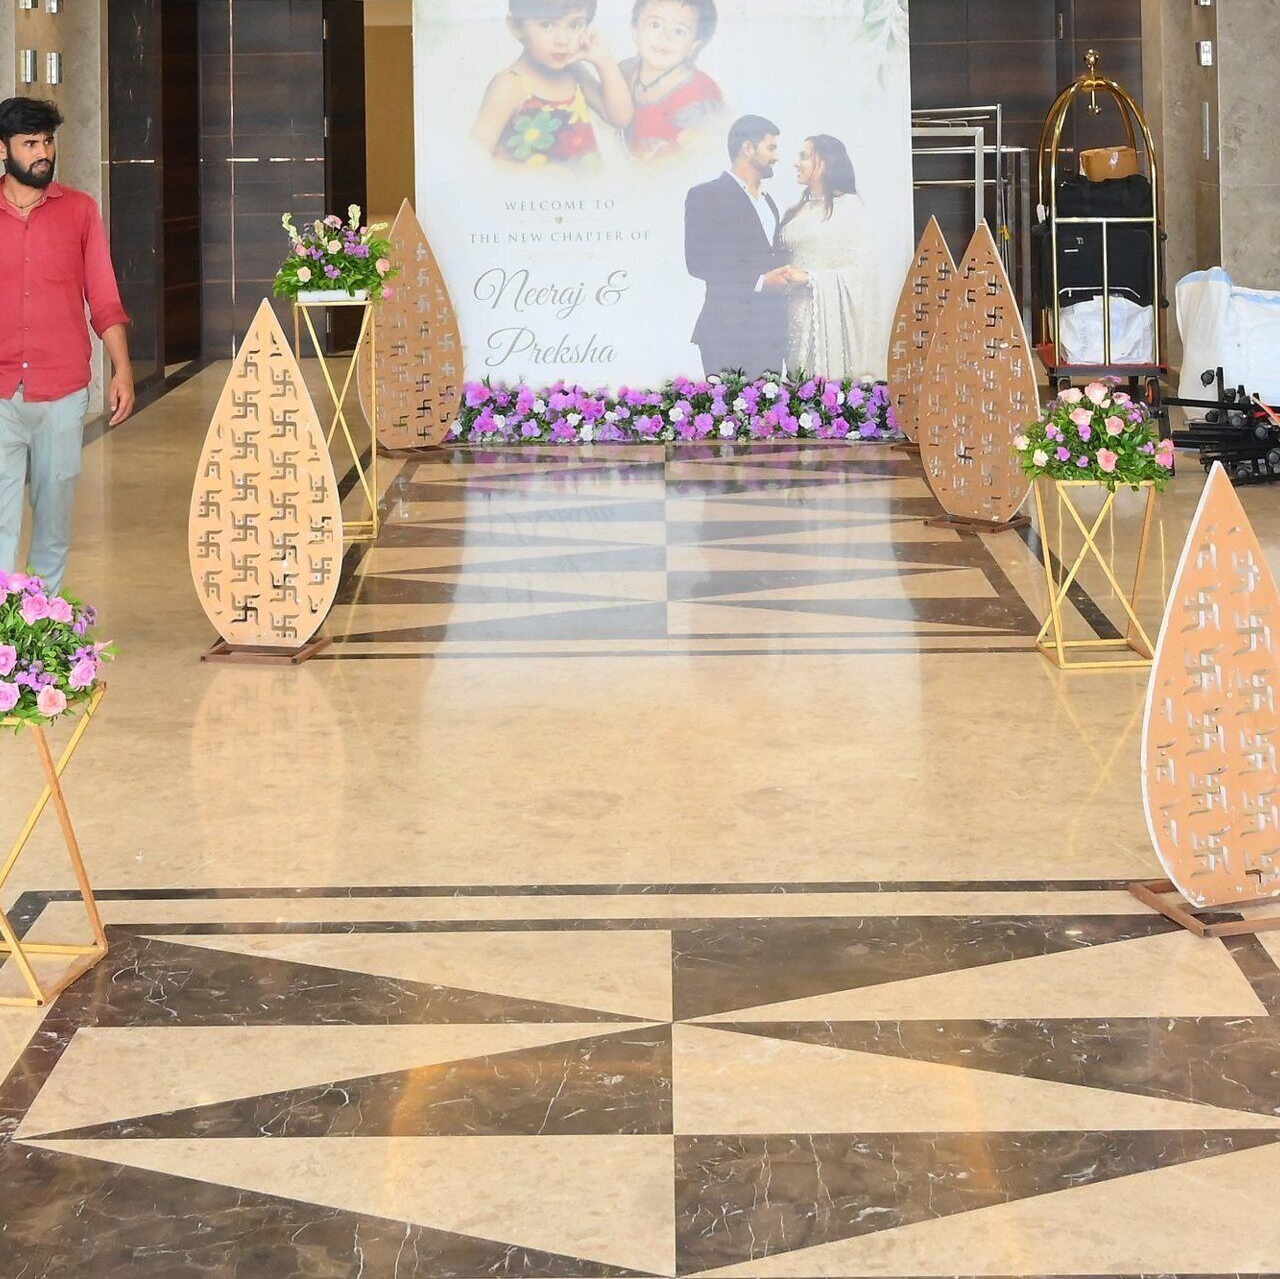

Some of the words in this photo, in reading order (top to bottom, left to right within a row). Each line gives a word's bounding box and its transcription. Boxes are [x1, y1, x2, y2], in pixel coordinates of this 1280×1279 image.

[504, 200, 586, 211] WELCOME
[595, 199, 616, 210] TO
[469, 234, 499, 244] THE
[508, 233, 544, 244] NEW
[551, 232, 624, 243] CHAPTER
[631, 231, 652, 241] OF
[473, 267, 586, 320] Neeraj
[595, 269, 631, 307] &
[485, 326, 618, 367] Preksha
